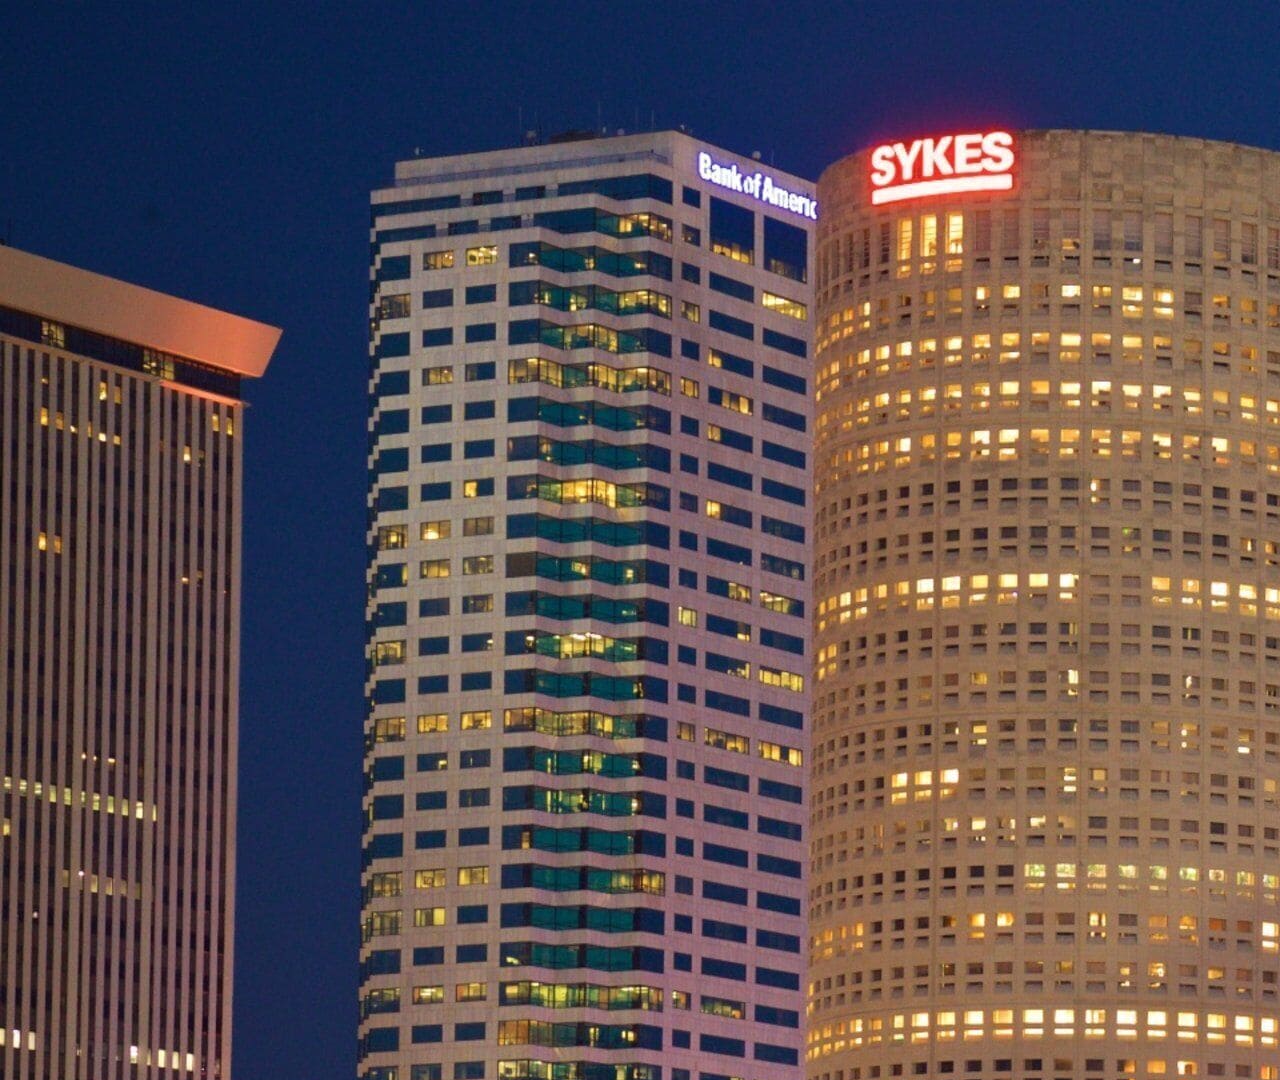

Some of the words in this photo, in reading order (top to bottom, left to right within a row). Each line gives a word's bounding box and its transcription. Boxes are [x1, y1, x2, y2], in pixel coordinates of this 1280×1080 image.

[698, 151, 743, 192] Bank
[743, 173, 762, 199] of
[871, 131, 1015, 187] SYKES
